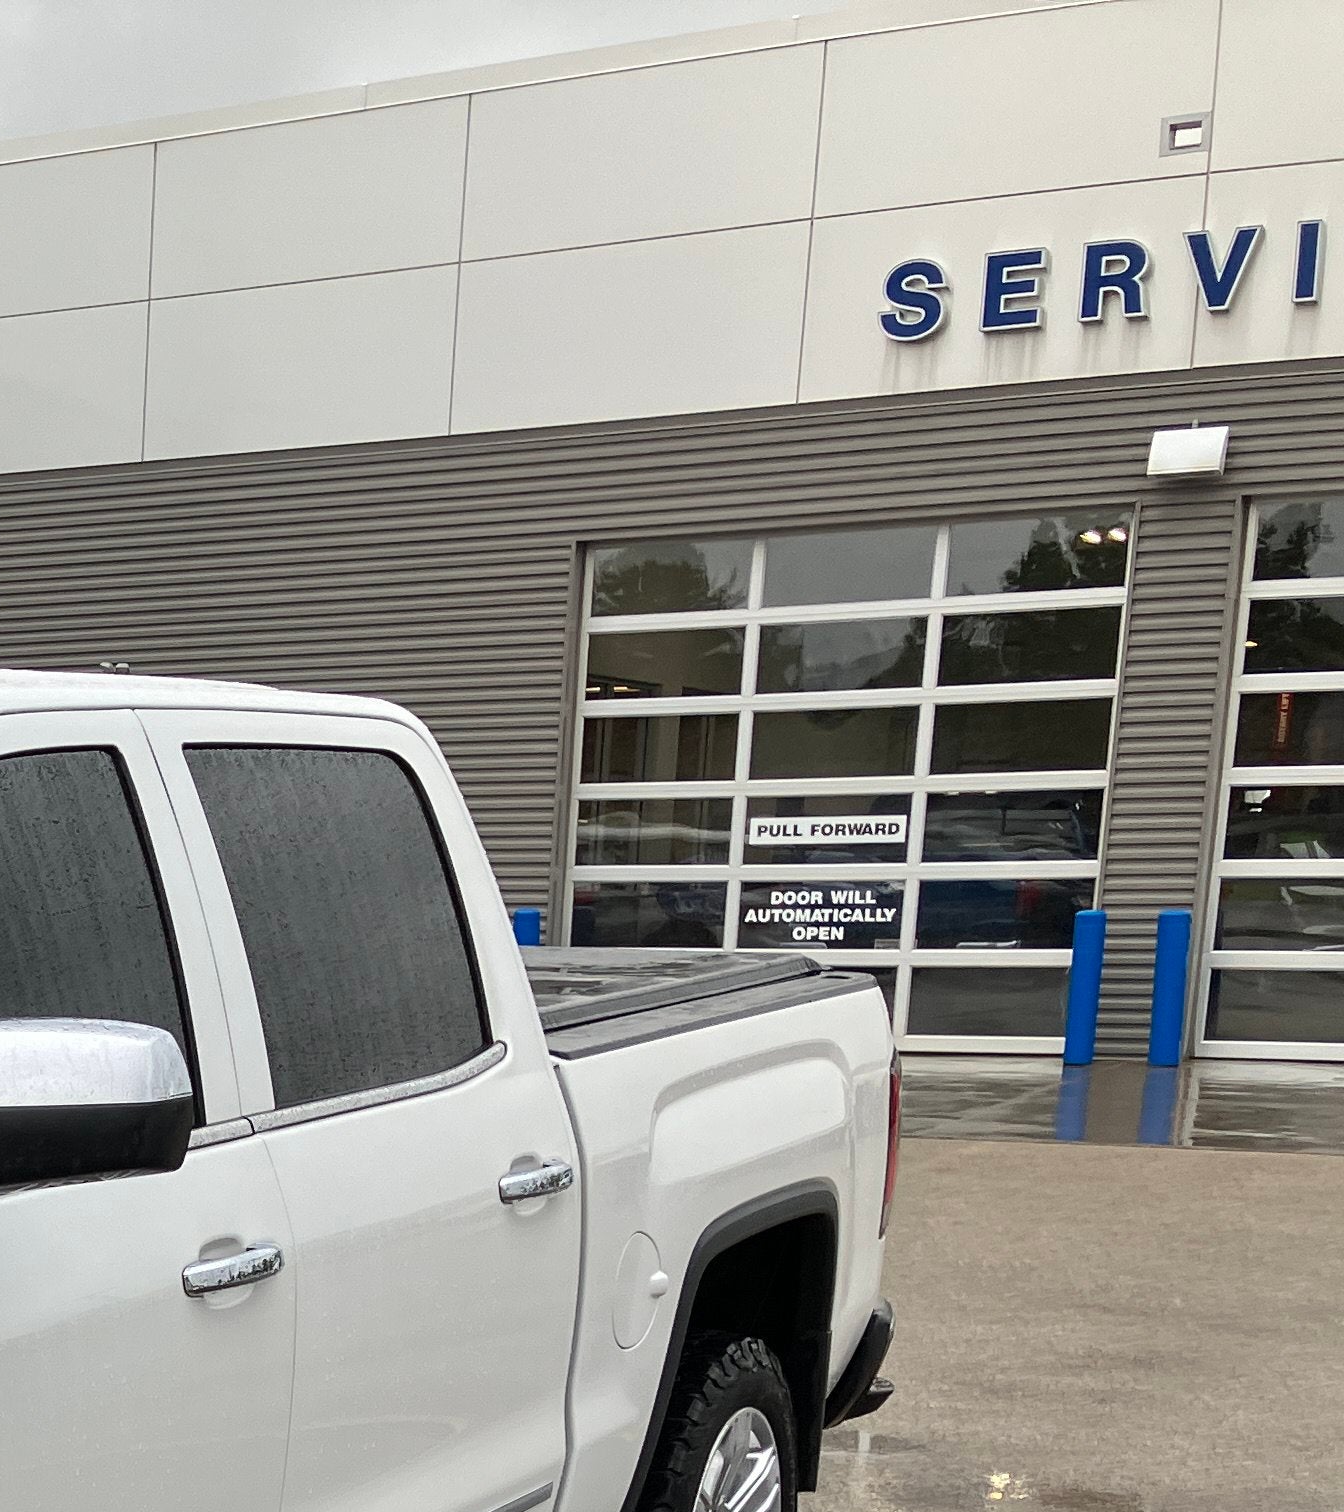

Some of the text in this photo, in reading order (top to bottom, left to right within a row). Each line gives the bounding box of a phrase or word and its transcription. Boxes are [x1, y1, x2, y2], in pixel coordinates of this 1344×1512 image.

[877, 218, 1325, 342] SERVI
[757, 812, 900, 837] PULL FORWARD
[770, 890, 877, 905] DOOR WILL
[744, 908, 896, 923] AUTOMATICALLY
[792, 926, 845, 940] OPEN
